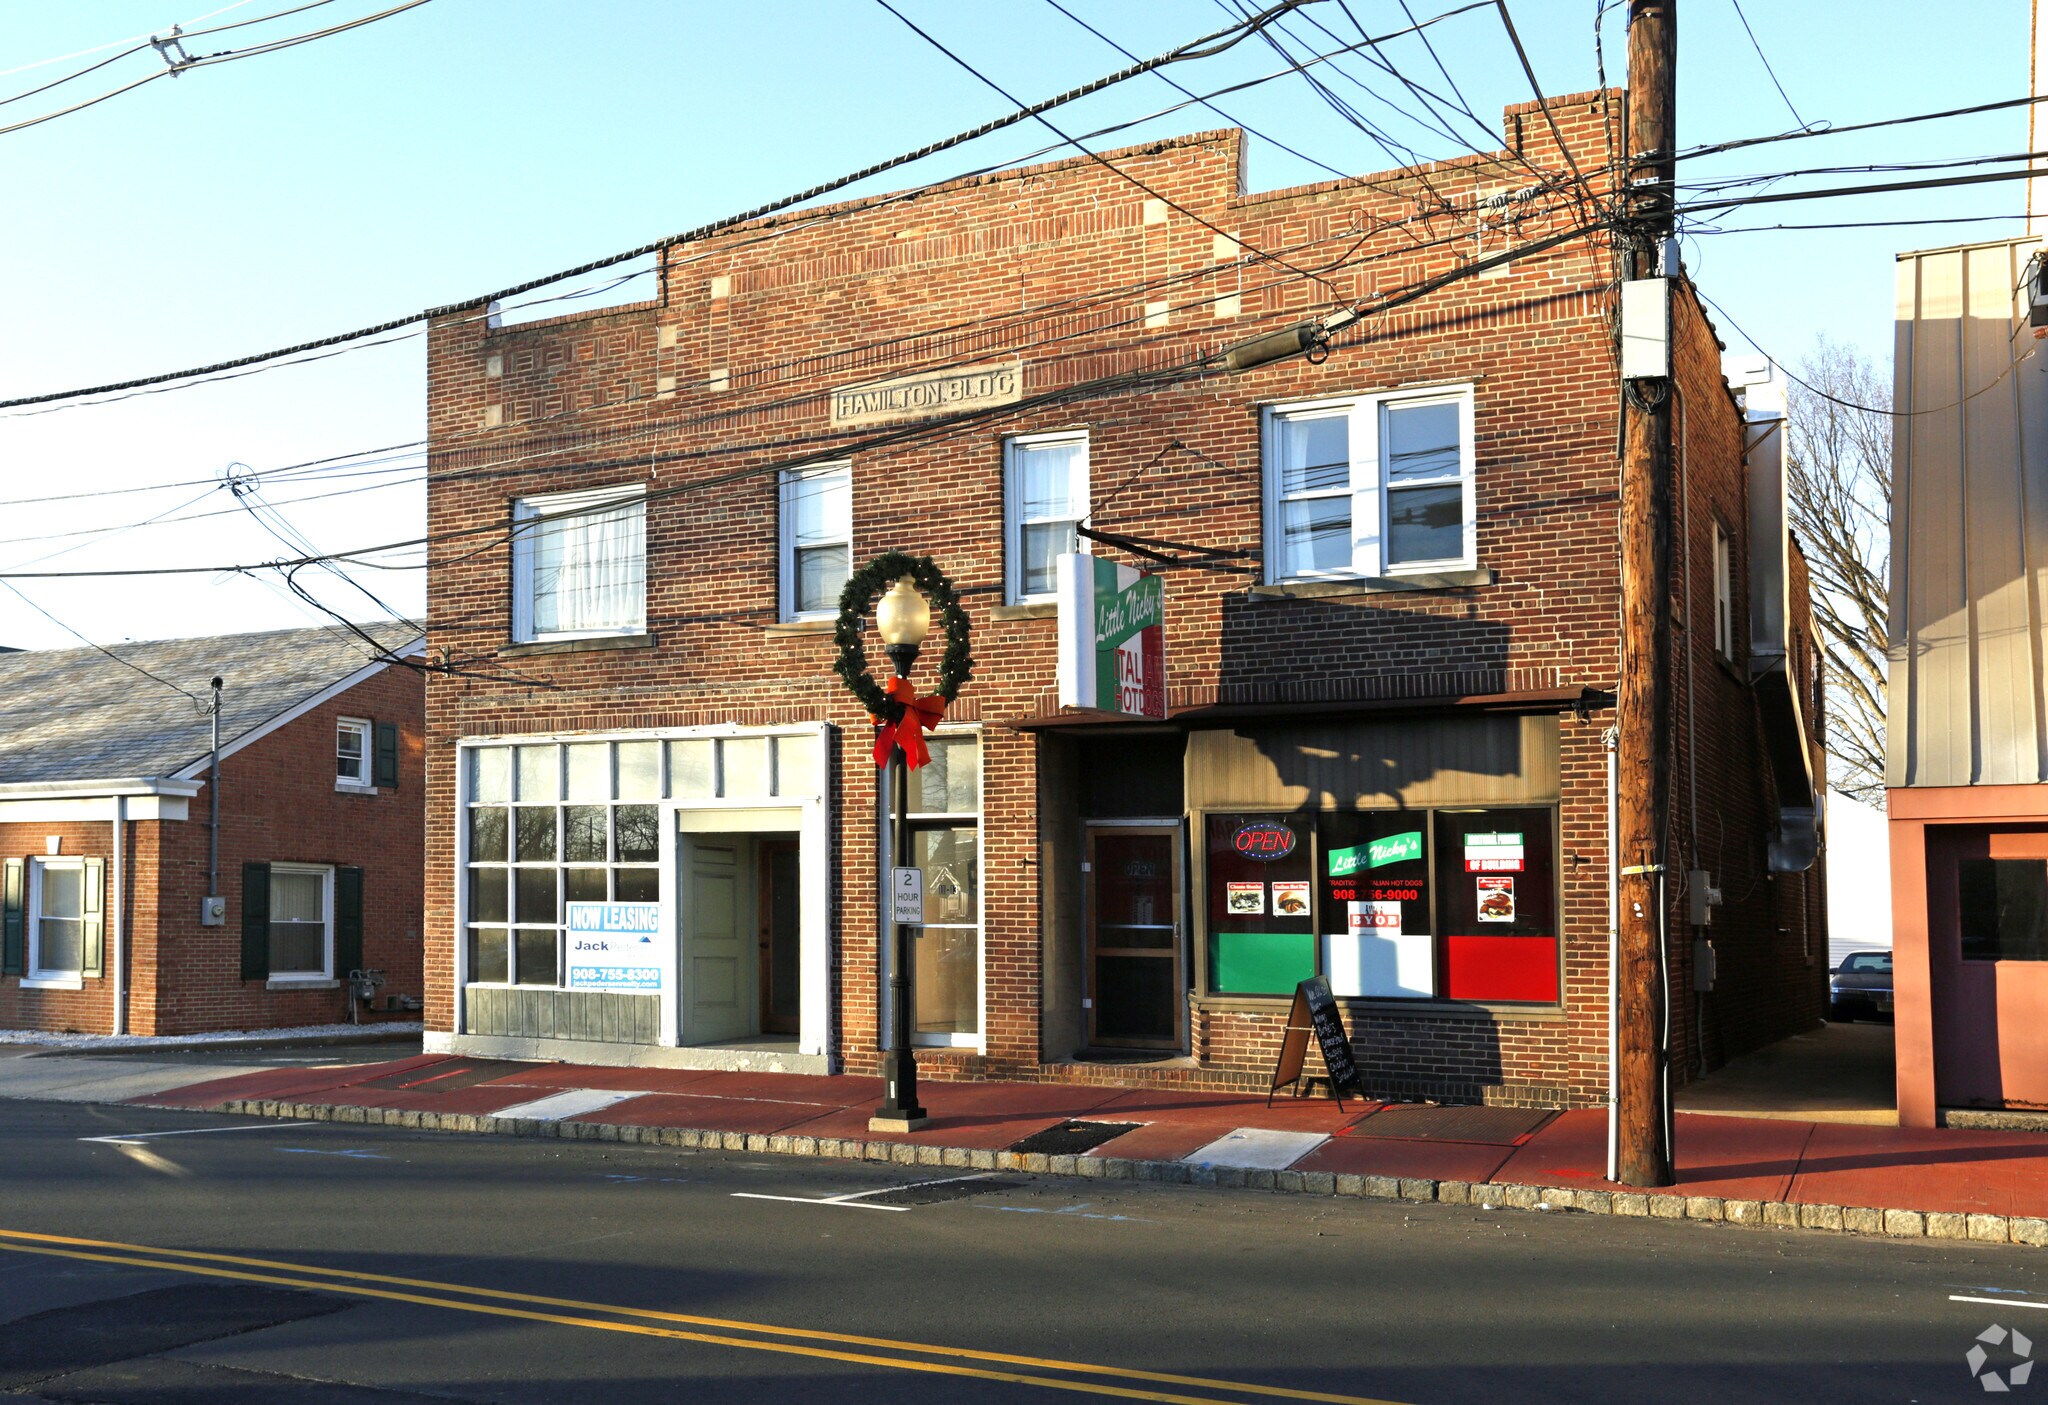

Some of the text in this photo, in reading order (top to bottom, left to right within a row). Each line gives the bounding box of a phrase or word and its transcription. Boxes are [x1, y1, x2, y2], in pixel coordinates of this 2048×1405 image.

[1096, 584, 1163, 644] Little Nicky's
[1114, 647, 1164, 688] ITALIAN
[1236, 831, 1291, 851] OPEN
[1331, 837, 1418, 874] Little Nicky's
[903, 873, 913, 886] 2
[897, 893, 919, 902] HOUR
[896, 906, 921, 915] PARKING
[572, 906, 658, 931] NOW LEASING
[1351, 915, 1399, 926] BYOB
[574, 940, 609, 951] Jack
[572, 968, 659, 981] 908-755-8300
